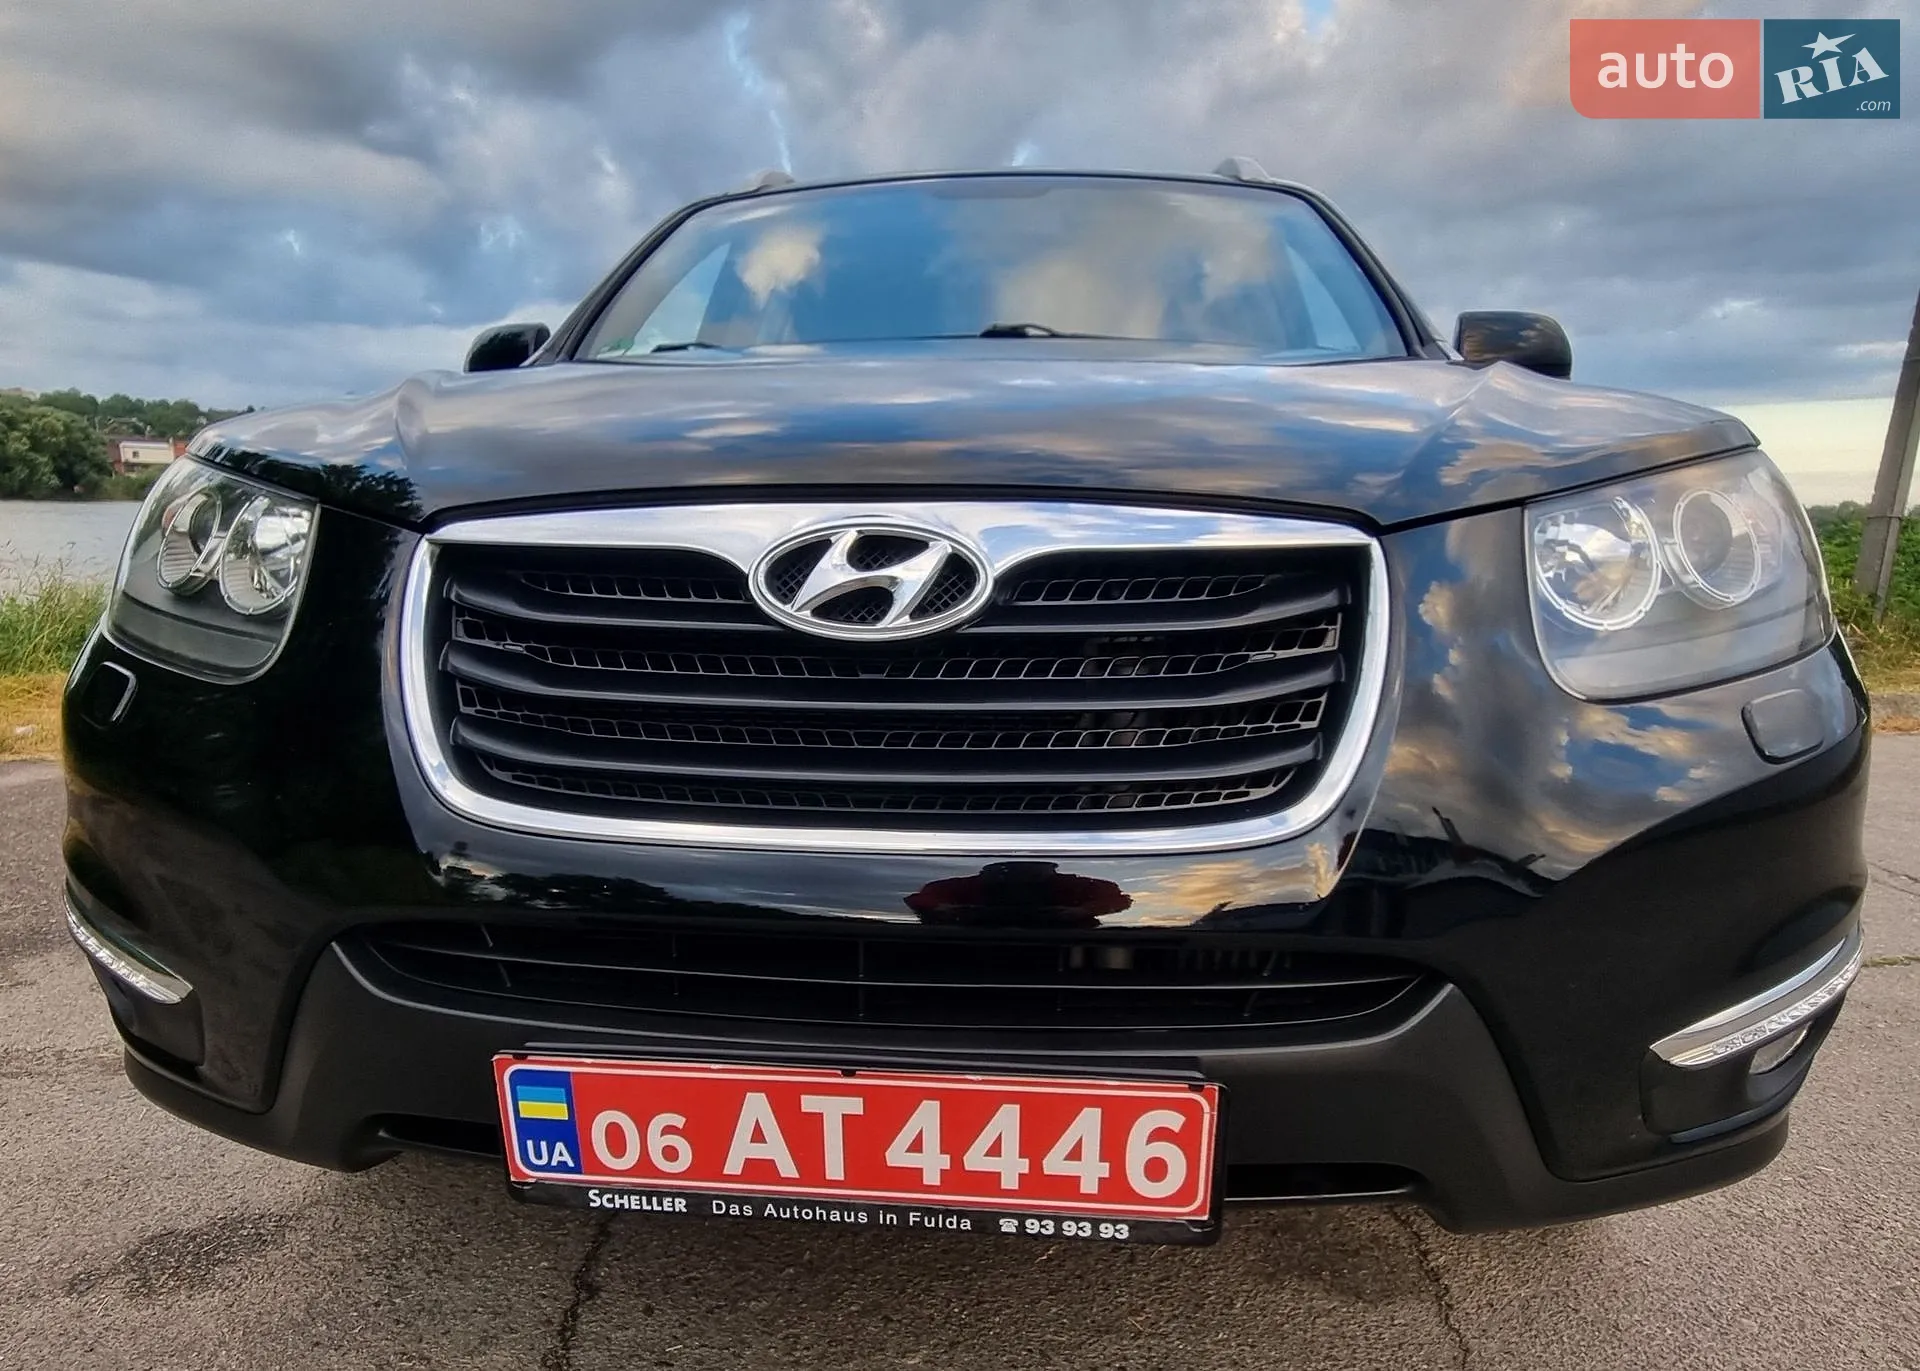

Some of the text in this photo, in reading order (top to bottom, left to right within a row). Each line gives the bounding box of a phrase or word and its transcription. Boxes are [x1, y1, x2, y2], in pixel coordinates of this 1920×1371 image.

[526, 1139, 575, 1168] UA
[590, 1091, 1188, 1199] 06 AT 4446
[588, 1189, 1130, 1240] SCHELLER Das Autohaus in Fulda 93 93 93
